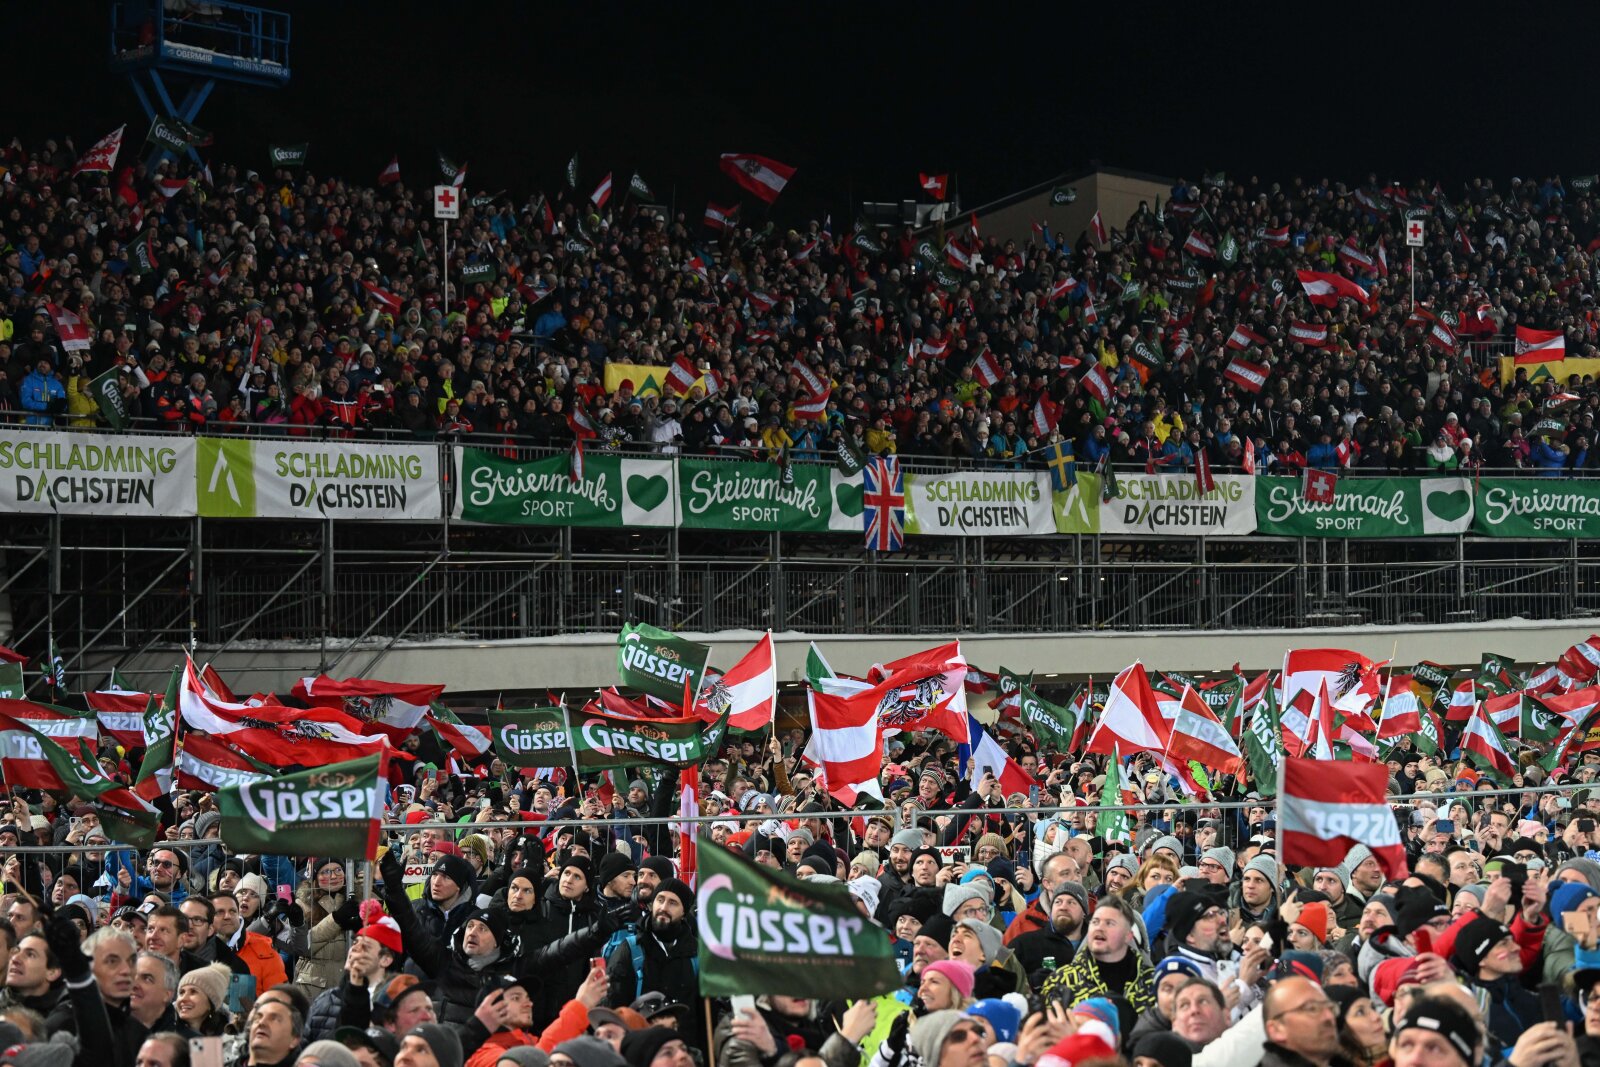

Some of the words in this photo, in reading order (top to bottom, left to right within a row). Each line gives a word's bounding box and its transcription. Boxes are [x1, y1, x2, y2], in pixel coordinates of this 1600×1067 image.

[1135, 341, 1160, 366] Gösser
[0, 440, 177, 474] SCHLADMING
[275, 451, 422, 483] SCHLADMING
[838, 440, 859, 467] össer
[16, 469, 155, 515] DACHSTEIN
[290, 477, 407, 518] DACHSTEIN
[470, 466, 616, 512] Steiermark
[926, 479, 1040, 503] SCHLADMING
[521, 500, 574, 518] SPORT
[732, 506, 780, 523] SPORT
[938, 502, 1029, 534] DACHSTEIN
[1123, 500, 1227, 532] DACHSTEIN
[1315, 517, 1364, 531] SPORT
[1533, 517, 1586, 531] SPORT
[622, 632, 695, 684] Gösser
[1024, 698, 1067, 736] Gösser
[582, 718, 694, 762] Gösser
[698, 872, 863, 962] Gösser
